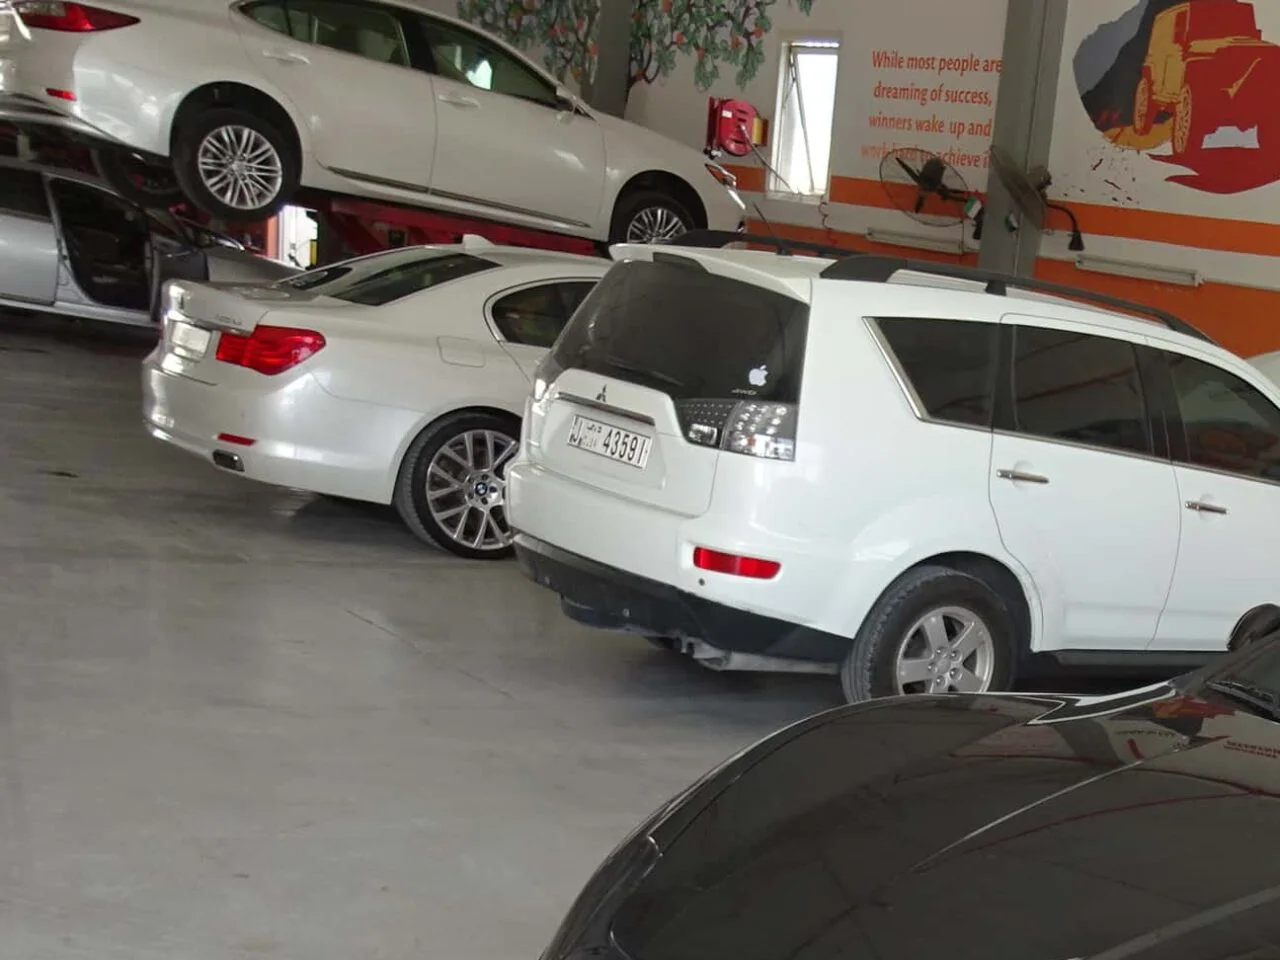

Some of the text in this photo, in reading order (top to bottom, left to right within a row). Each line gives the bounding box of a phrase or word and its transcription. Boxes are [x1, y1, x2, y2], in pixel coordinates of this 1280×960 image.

[872, 50, 1004, 76] While most people are
[873, 80, 993, 107] dreaming of success,
[868, 111, 993, 141] winners wake up and
[603, 428, 647, 464] 43591
